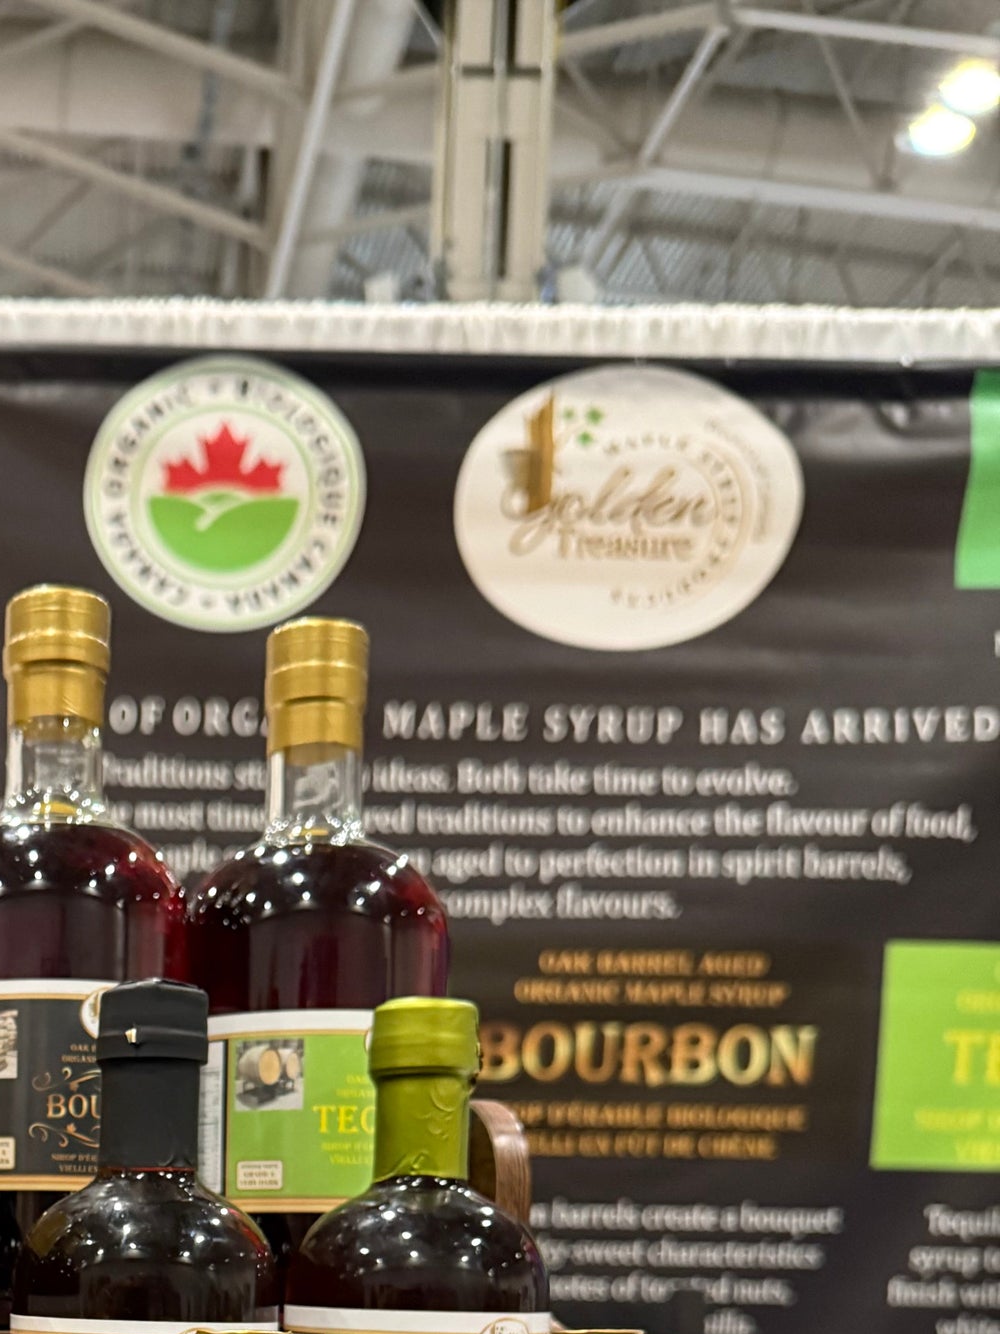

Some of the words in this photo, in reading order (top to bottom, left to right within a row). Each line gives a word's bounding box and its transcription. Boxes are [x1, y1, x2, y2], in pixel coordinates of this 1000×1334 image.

[109, 695, 166, 736] OF
[383, 699, 529, 741] MAPLE
[543, 702, 683, 744] SYRUP
[700, 706, 786, 746] HAS
[801, 705, 1000, 746] ARRIVED
[457, 757, 527, 795] Both
[528, 758, 593, 795] take
[593, 761, 660, 796] time
[662, 764, 696, 797] to
[696, 761, 799, 797] evolve.
[135, 800, 206, 832] most
[416, 799, 557, 836] traditions
[557, 805, 591, 837] to
[591, 801, 712, 837] enhance
[714, 801, 765, 837] the
[766, 801, 869, 837] flavour
[871, 801, 907, 838] of
[905, 802, 978, 843] food,
[432, 841, 504, 884] aged
[504, 845, 539, 878] to
[538, 841, 688, 885] perfection
[688, 843, 720, 878] in
[720, 843, 802, 885] spirit
[803, 842, 913, 885] barrels,
[556, 881, 684, 919] flavours.
[538, 949, 594, 976] OAK
[596, 950, 694, 977] BARREL
[699, 951, 771, 979] AGED
[513, 976, 621, 1005] ORGANIC
[623, 979, 706, 1008] MAPLE
[707, 980, 792, 1009] SYRUP
[479, 1020, 819, 1087] BOURBON
[552, 1197, 642, 1231] barrels
[641, 1204, 720, 1232] create
[740, 1200, 845, 1240] bouquet
[571, 1238, 647, 1267] sweet
[646, 1234, 827, 1271] characteristics
[908, 1246, 983, 1280] syrup
[887, 1274, 960, 1308] finish
